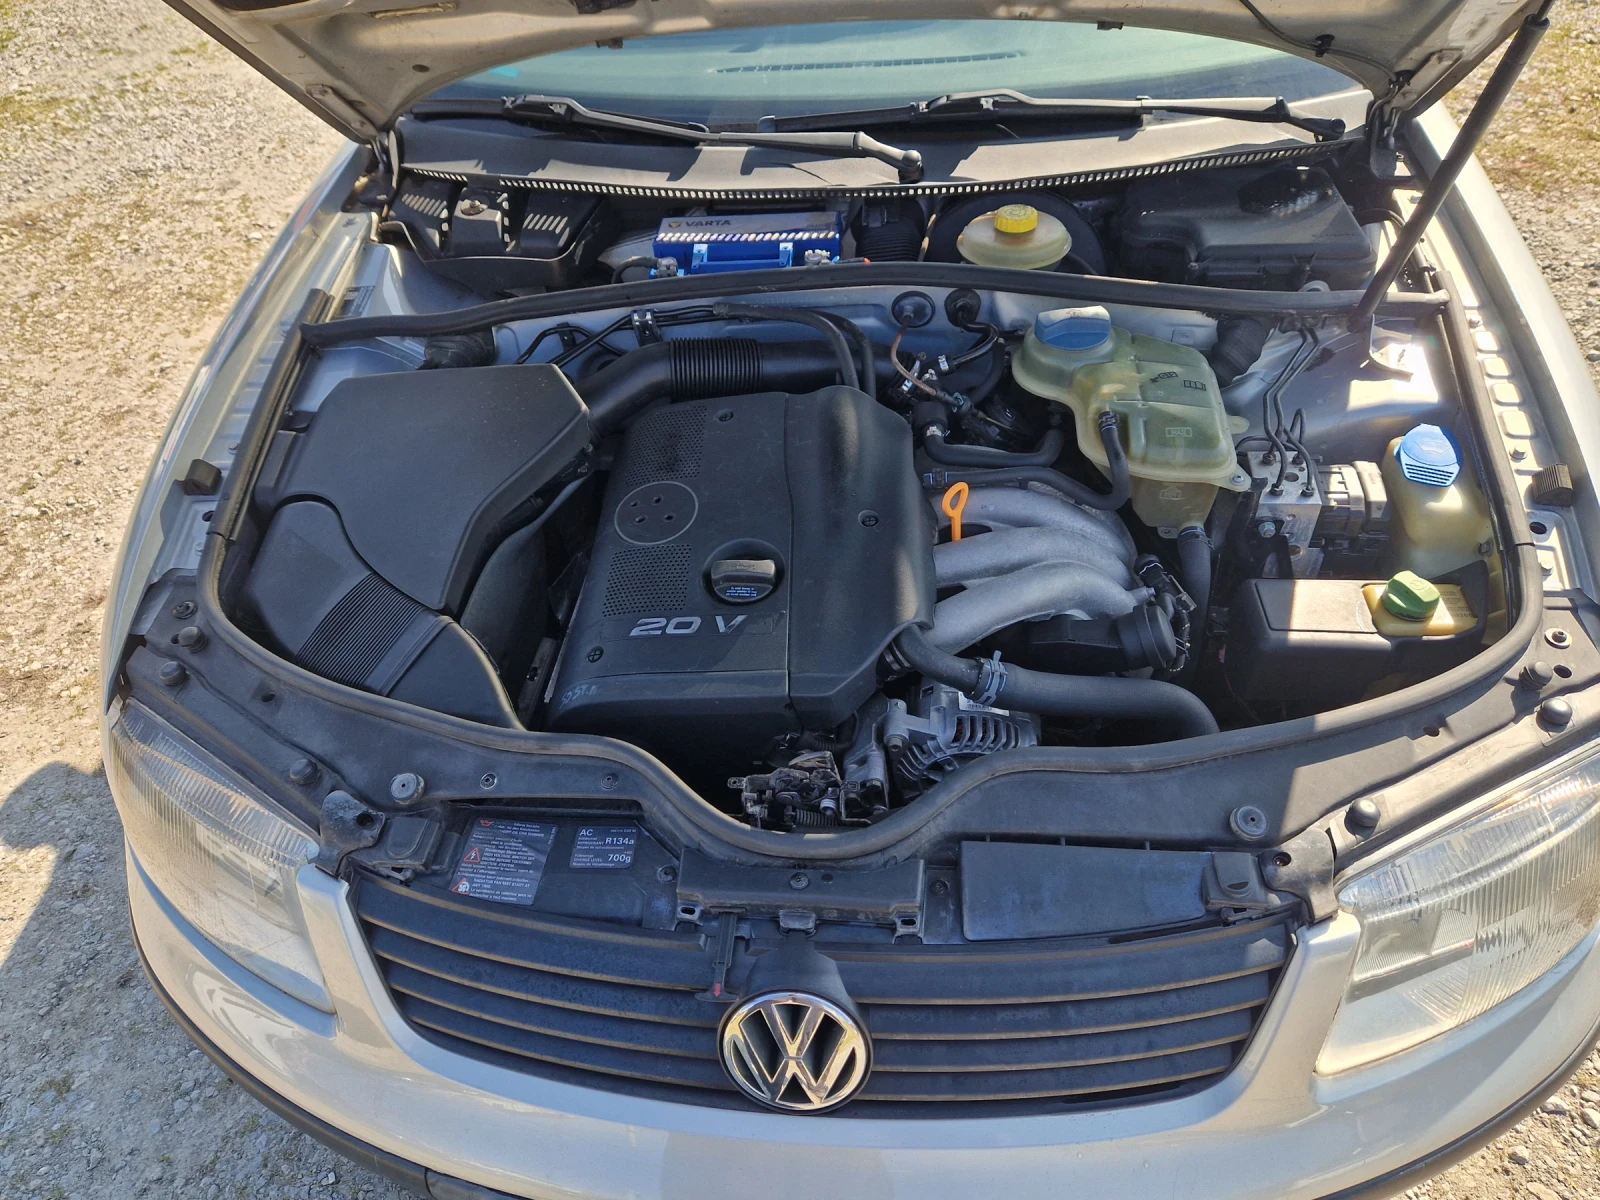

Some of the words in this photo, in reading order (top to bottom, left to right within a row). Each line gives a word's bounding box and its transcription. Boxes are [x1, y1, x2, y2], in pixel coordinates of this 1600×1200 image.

[686, 219, 732, 228] VARTA
[629, 616, 702, 637] 20
[715, 614, 748, 634] V
[605, 837, 634, 845] R134a
[608, 854, 631, 863] 700g
[723, 991, 867, 1111] VW
